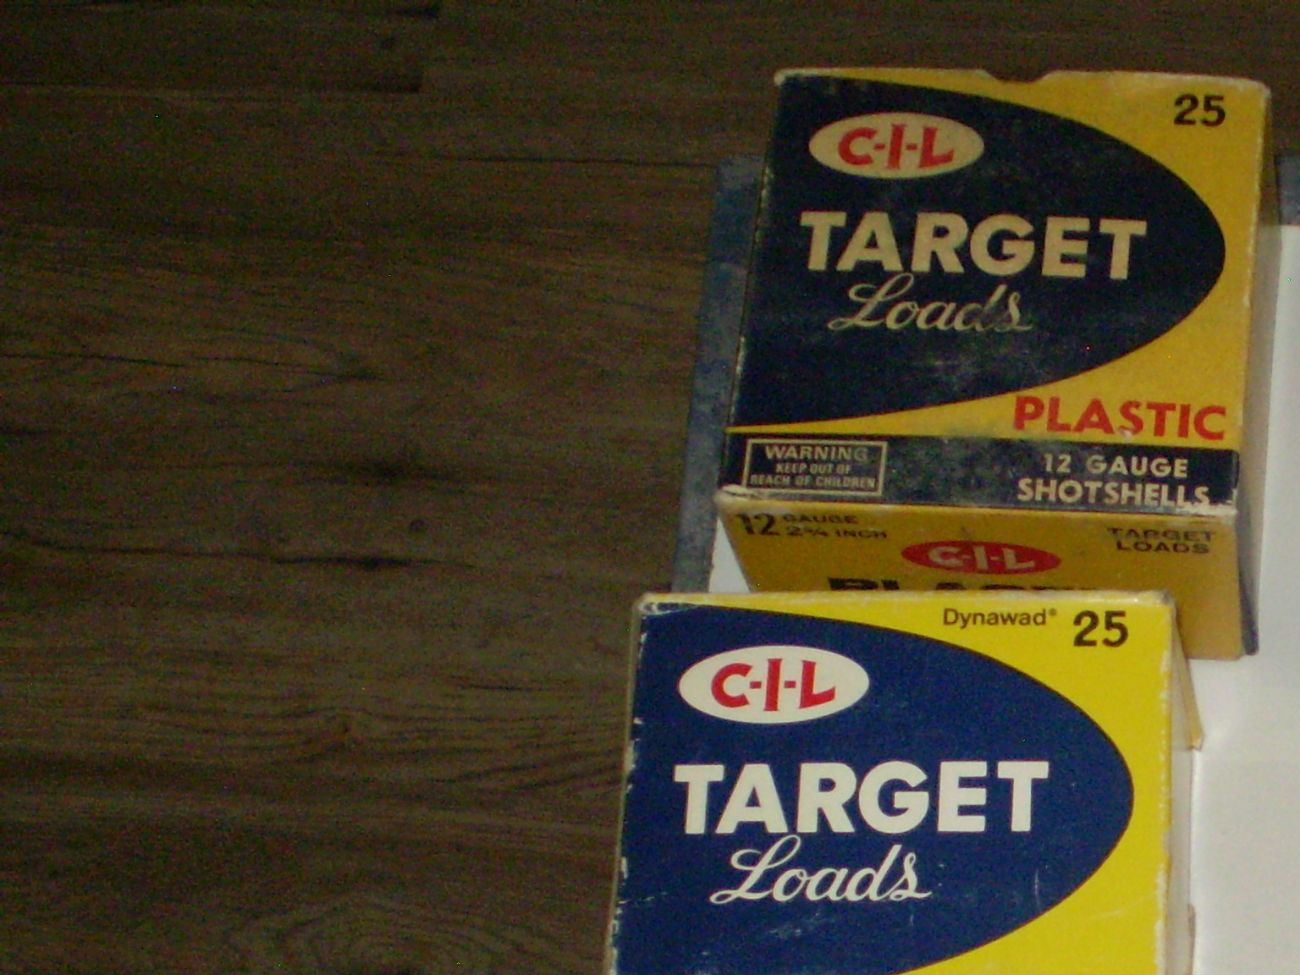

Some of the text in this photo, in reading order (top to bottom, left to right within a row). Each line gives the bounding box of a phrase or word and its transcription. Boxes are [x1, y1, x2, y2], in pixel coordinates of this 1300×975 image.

[1173, 94, 1225, 127] 25
[838, 123, 954, 171] C-I-L
[800, 211, 1147, 280] TARGET
[827, 272, 1033, 332] Loads
[1013, 395, 1227, 440] PLASTIC
[765, 445, 868, 461] WARNING
[1044, 453, 1188, 478] 12 GAUGE
[751, 474, 876, 488] REACH OF CHILDREN
[776, 463, 851, 474] KEEP OUT OF
[1017, 478, 1210, 507] SHOTSHELLS
[736, 513, 858, 536] 12 GAUGE
[836, 528, 887, 538] INCH
[1108, 527, 1216, 541] TARGET
[927, 546, 1036, 570] C-I-L
[1116, 541, 1210, 554] LOADS
[1072, 610, 1129, 647] 25
[710, 657, 836, 712] C-I-L
[673, 760, 1049, 834] TARGET
[709, 835, 932, 904] Loads
